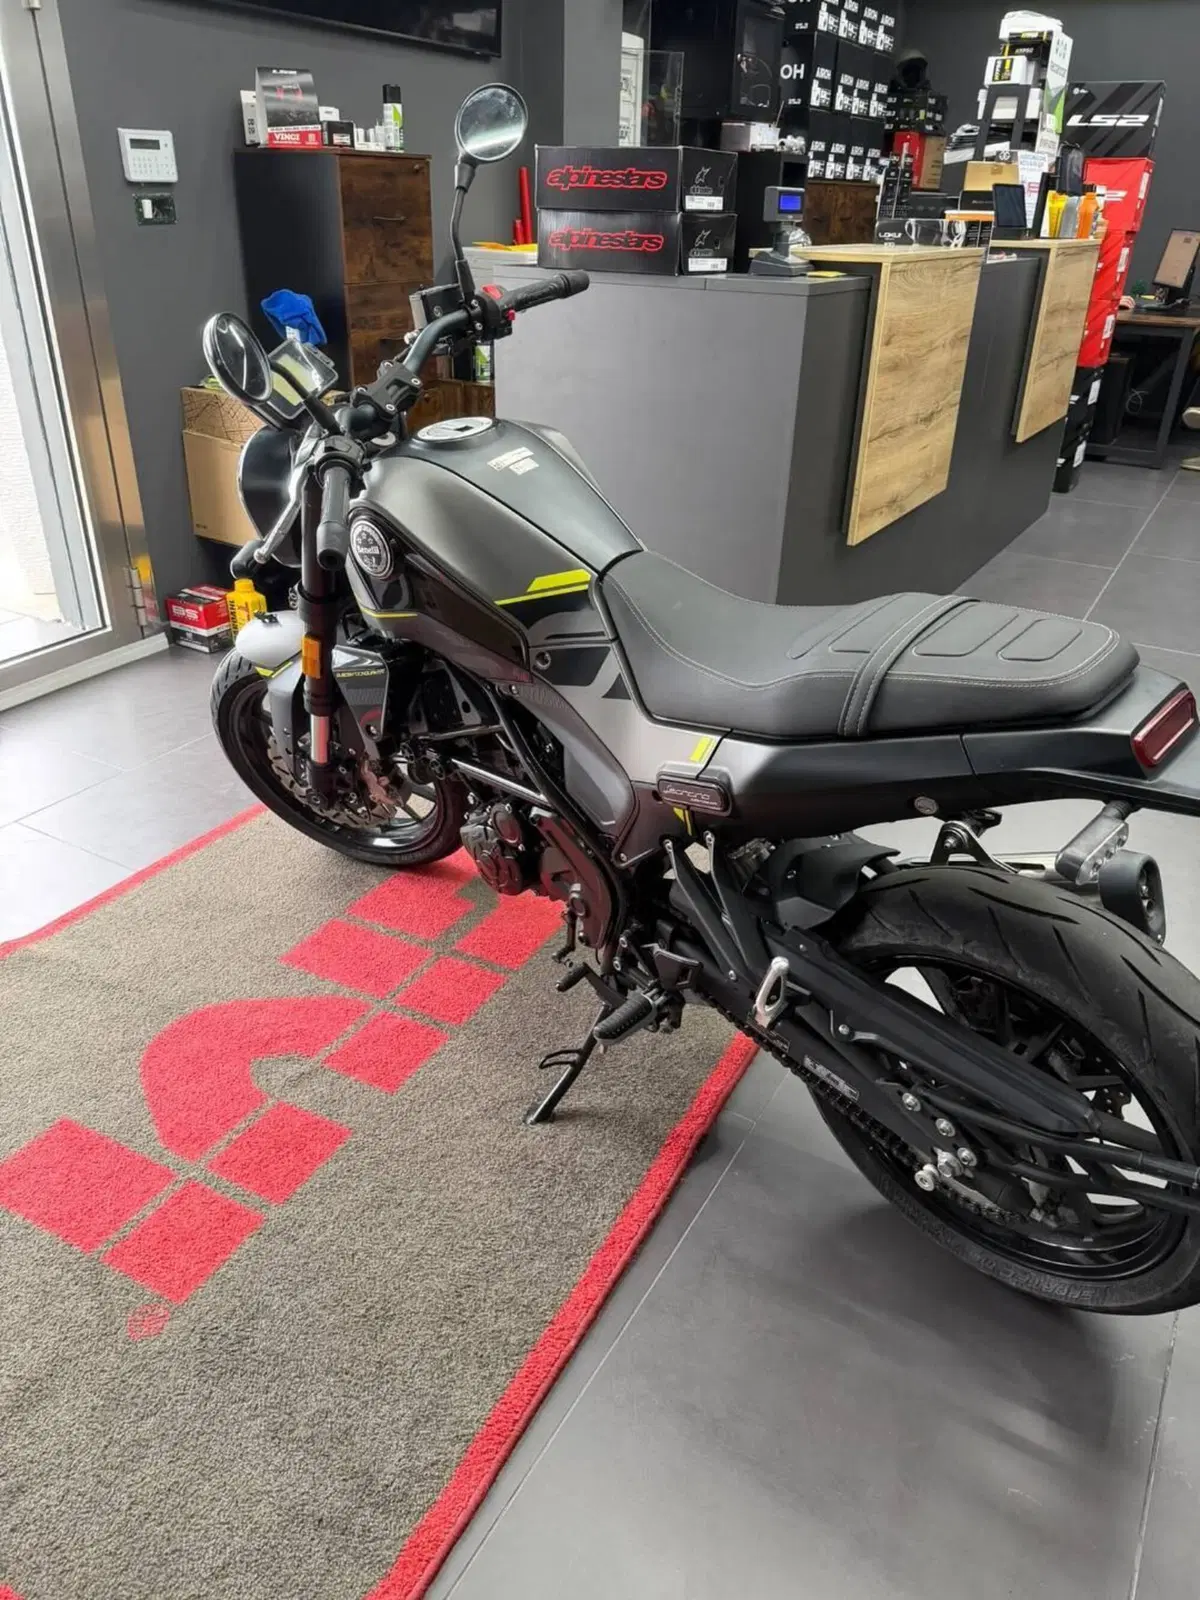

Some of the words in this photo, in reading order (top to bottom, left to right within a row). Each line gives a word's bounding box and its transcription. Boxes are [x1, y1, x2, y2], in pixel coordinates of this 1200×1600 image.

[1066, 114, 1150, 126] LS2
[547, 165, 667, 190] alpinestars
[548, 228, 664, 251] alpinestars
[171, 605, 199, 619] BS
